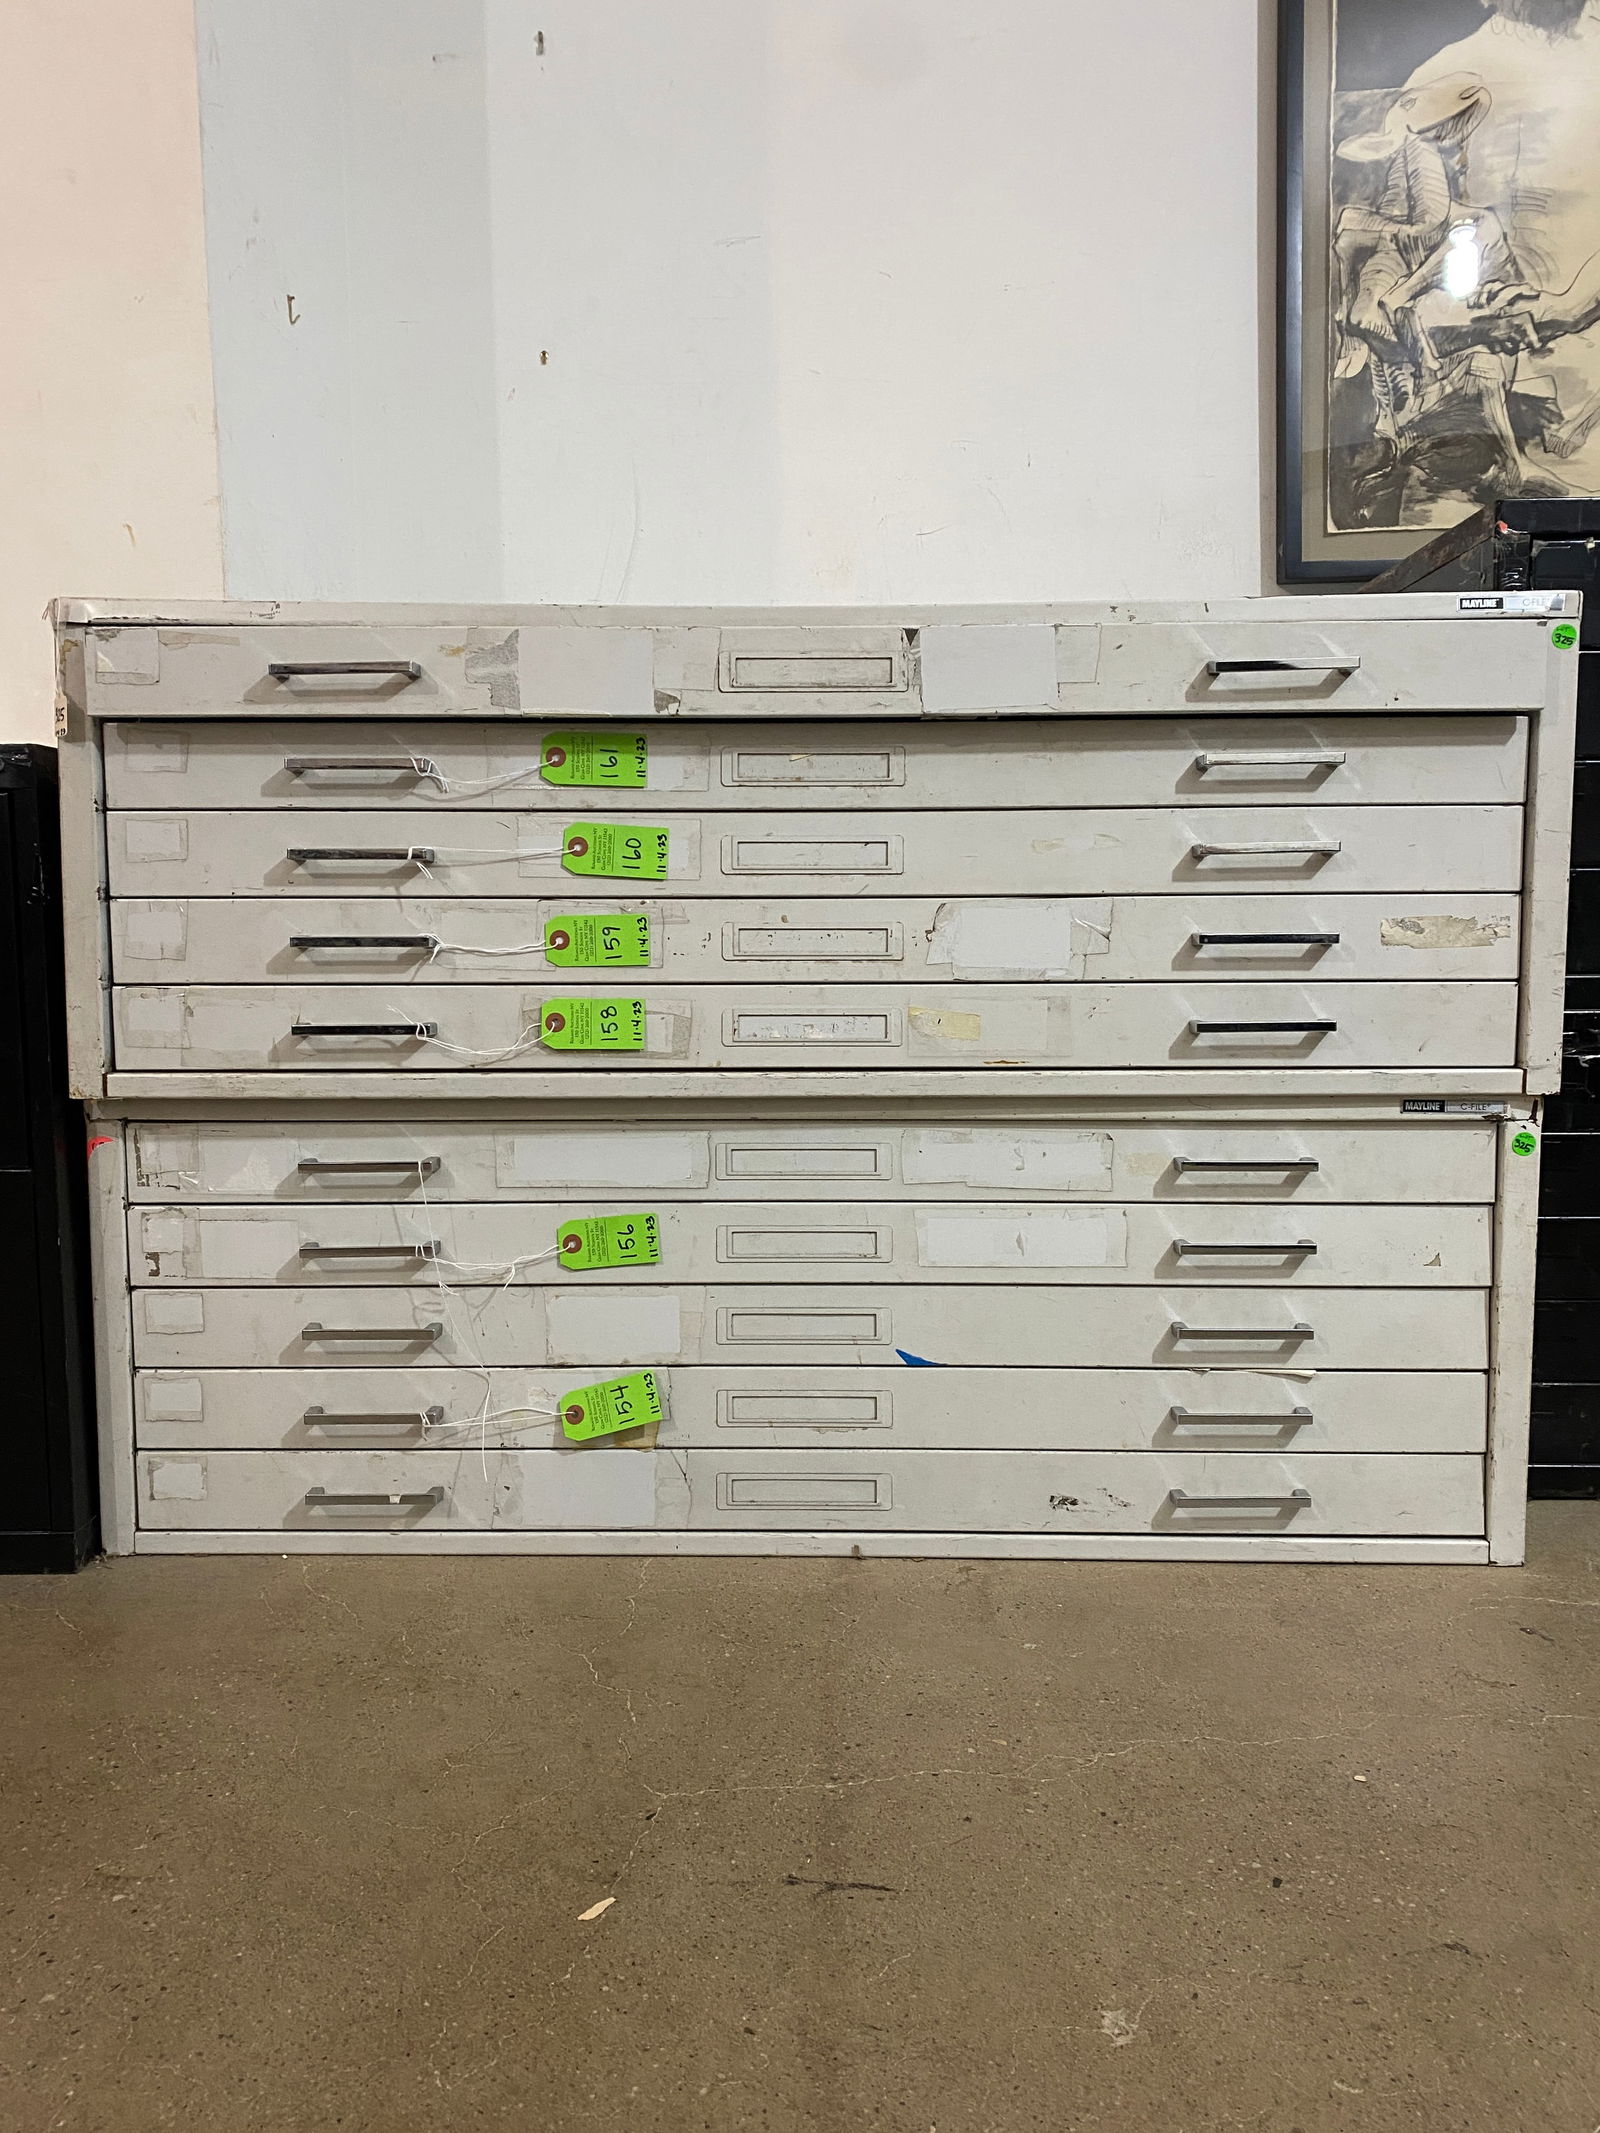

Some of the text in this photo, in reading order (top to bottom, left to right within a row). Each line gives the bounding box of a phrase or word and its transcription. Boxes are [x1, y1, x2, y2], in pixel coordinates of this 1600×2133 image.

[1461, 598, 1499, 608] MAYLINE
[1554, 633, 1576, 646] 325
[600, 748, 619, 778] 161
[622, 838, 642, 869] 160
[602, 926, 623, 960] 159
[600, 1005, 618, 1041] 158
[1405, 1101, 1441, 1111] MAYLINE
[1514, 1138, 1535, 1153] 325
[617, 1223, 638, 1259] 156
[609, 1385, 636, 1425] 154
